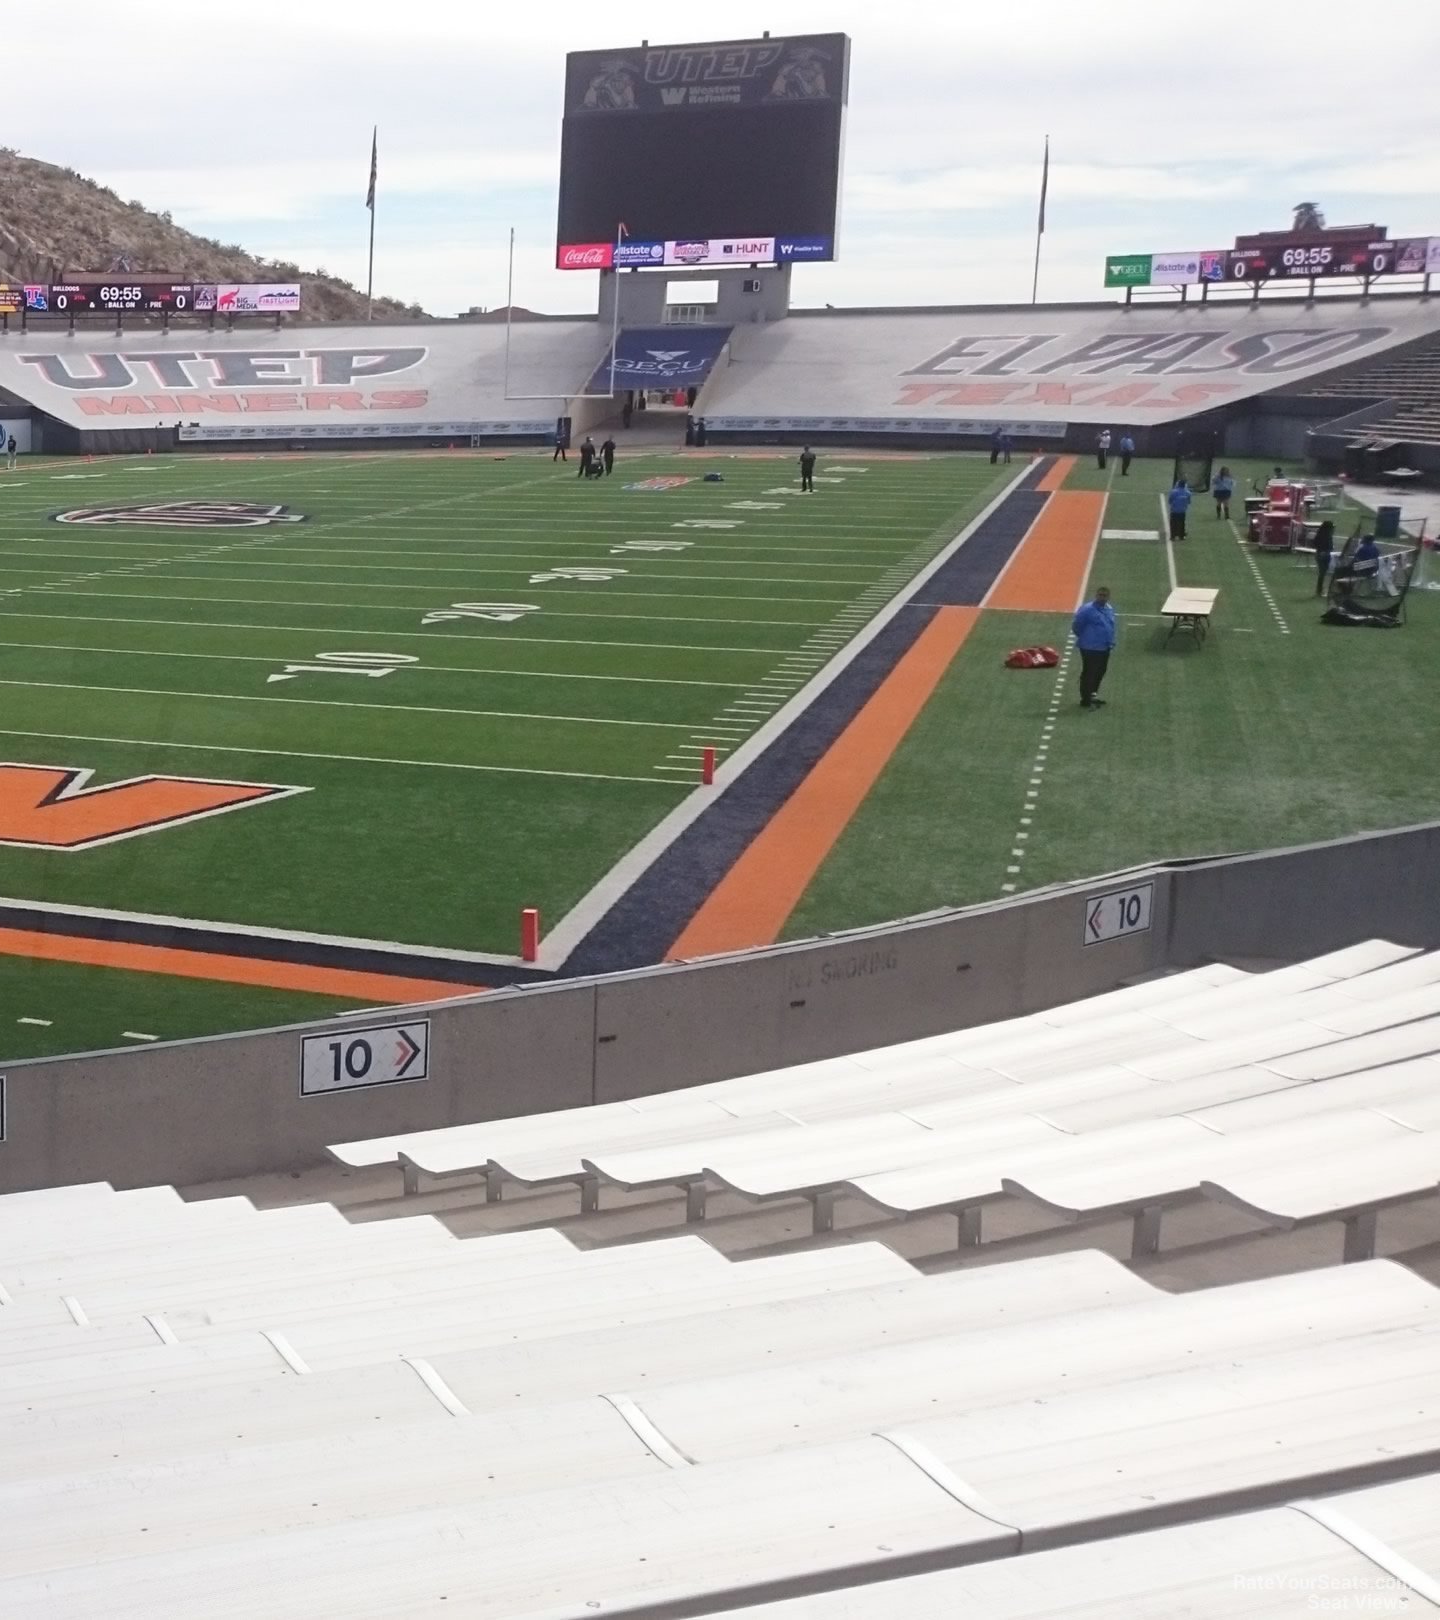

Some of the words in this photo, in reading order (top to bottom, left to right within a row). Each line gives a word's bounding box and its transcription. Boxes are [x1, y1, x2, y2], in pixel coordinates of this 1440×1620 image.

[645, 44, 785, 83] UTEP
[689, 86, 740, 95] Western
[689, 94, 740, 104] Refining
[613, 245, 650, 255] Allstate
[736, 243, 769, 253] HUNT
[1283, 247, 1332, 265] 69:55
[1154, 263, 1185, 273] Allstate
[1234, 262, 1245, 278] 0
[1373, 254, 1385, 271] 0
[57, 295, 67, 308] 0
[100, 287, 141, 300] 69:55
[176, 295, 186, 308] 0
[900, 334, 1066, 376] EL
[1044, 328, 1395, 376] PASO
[15, 346, 429, 391] UTEP
[612, 358, 712, 370] GECU
[72, 390, 428, 415] MINERS
[892, 382, 1242, 407] TEXAS
[426, 602, 541, 621] 20
[284, 651, 420, 678] 10
[1120, 895, 1141, 929] 10
[329, 1039, 373, 1080] 10
